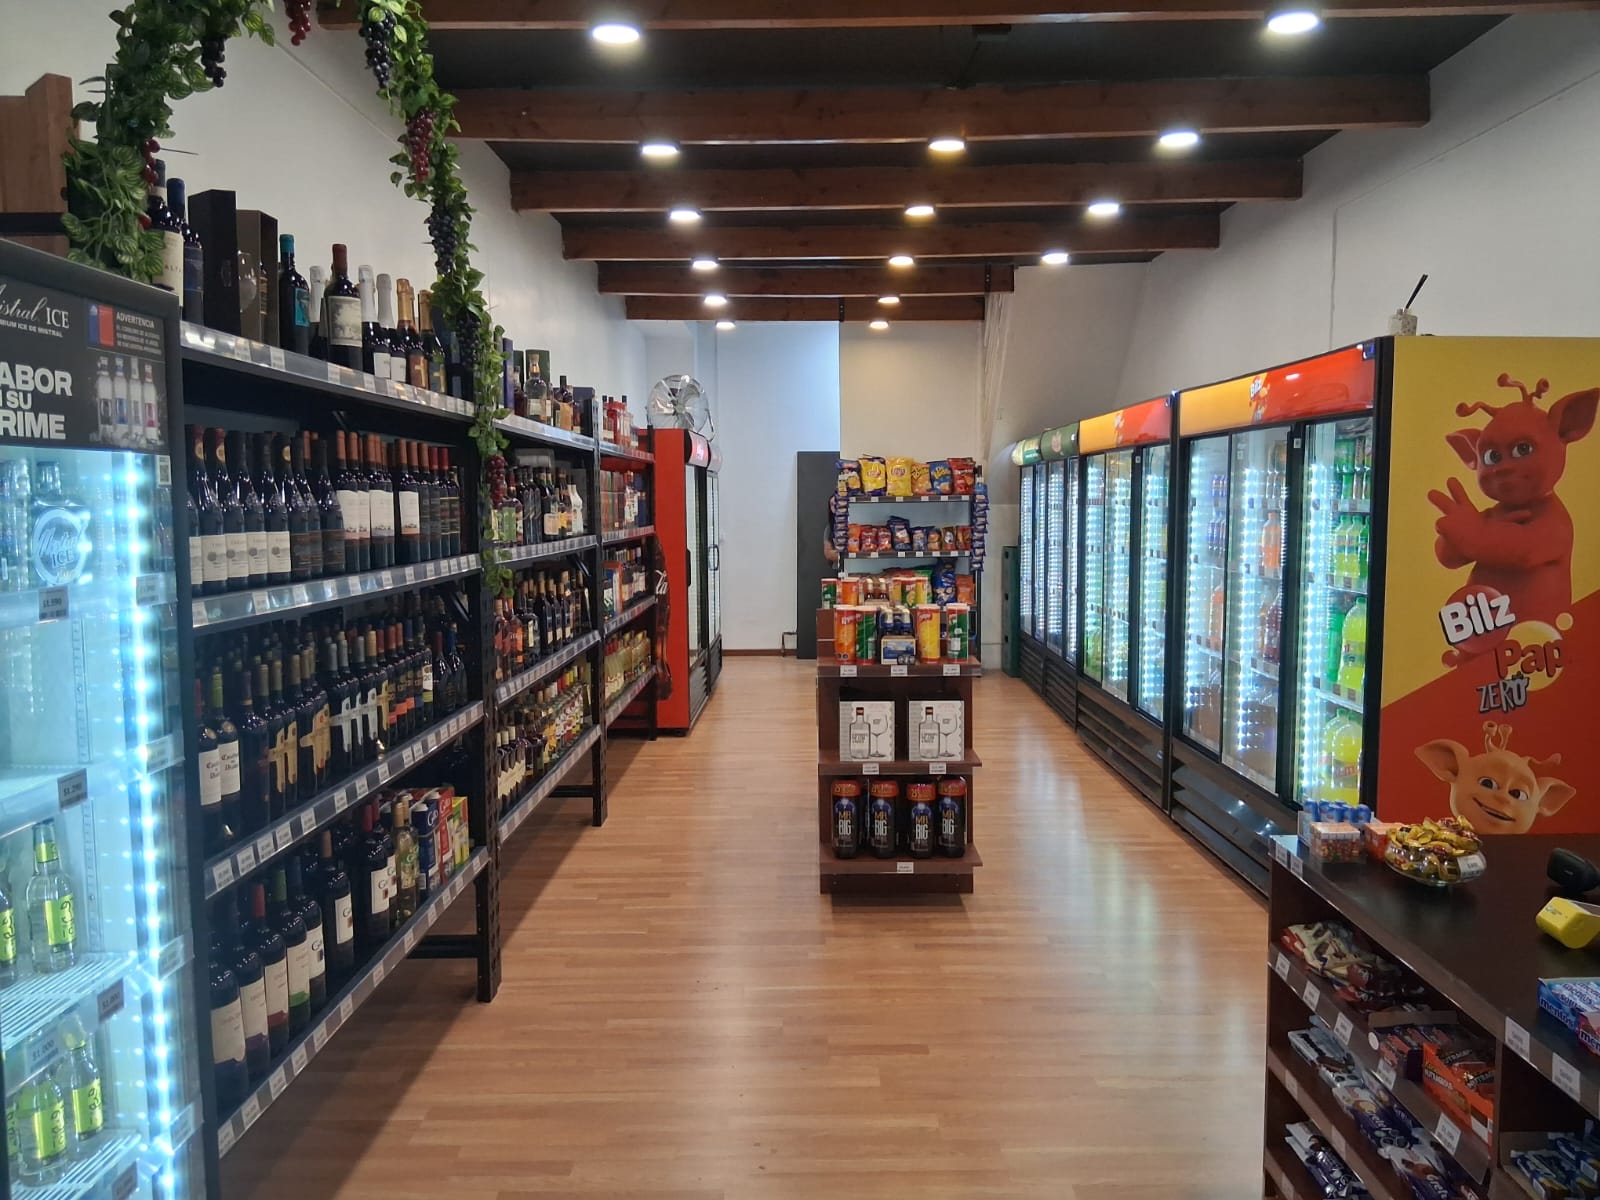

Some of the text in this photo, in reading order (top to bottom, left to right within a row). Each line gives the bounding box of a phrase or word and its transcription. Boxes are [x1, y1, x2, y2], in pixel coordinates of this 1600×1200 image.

[46, 307, 70, 329] ICE
[116, 311, 155, 328] ADVERTENCIA
[6, 391, 32, 410] SU
[1440, 593, 1516, 643] Bilz
[1476, 673, 1530, 713] ZERO
[838, 820, 852, 836] BIG
[874, 820, 888, 836] BIG
[915, 824, 929, 841] BIG
[942, 818, 955, 835] BIG
[1539, 997, 1576, 1031] mentos
